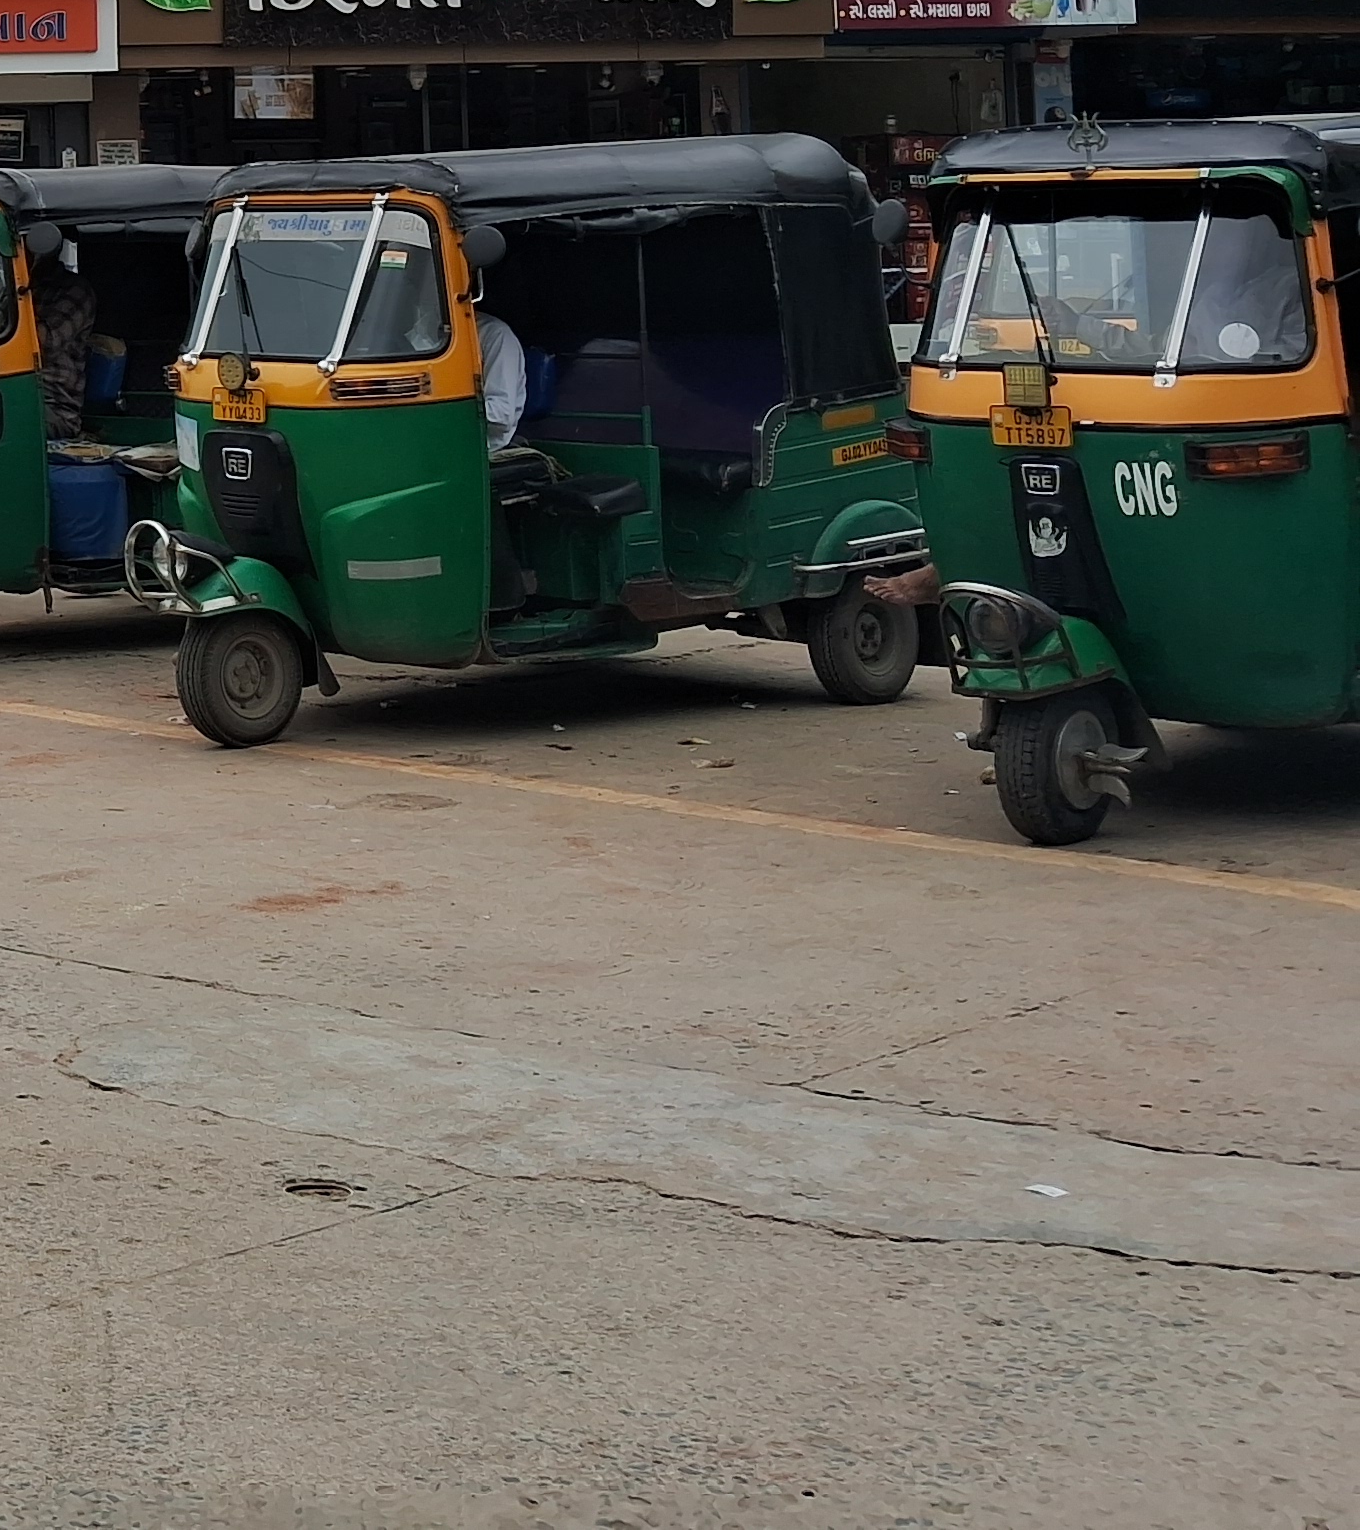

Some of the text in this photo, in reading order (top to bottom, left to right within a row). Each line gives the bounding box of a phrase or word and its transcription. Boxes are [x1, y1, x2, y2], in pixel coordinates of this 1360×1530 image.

[1004, 428, 1066, 445] TT5897
[228, 458, 247, 473] RE
[1028, 474, 1054, 488] RE
[1115, 461, 1178, 517] CNG
